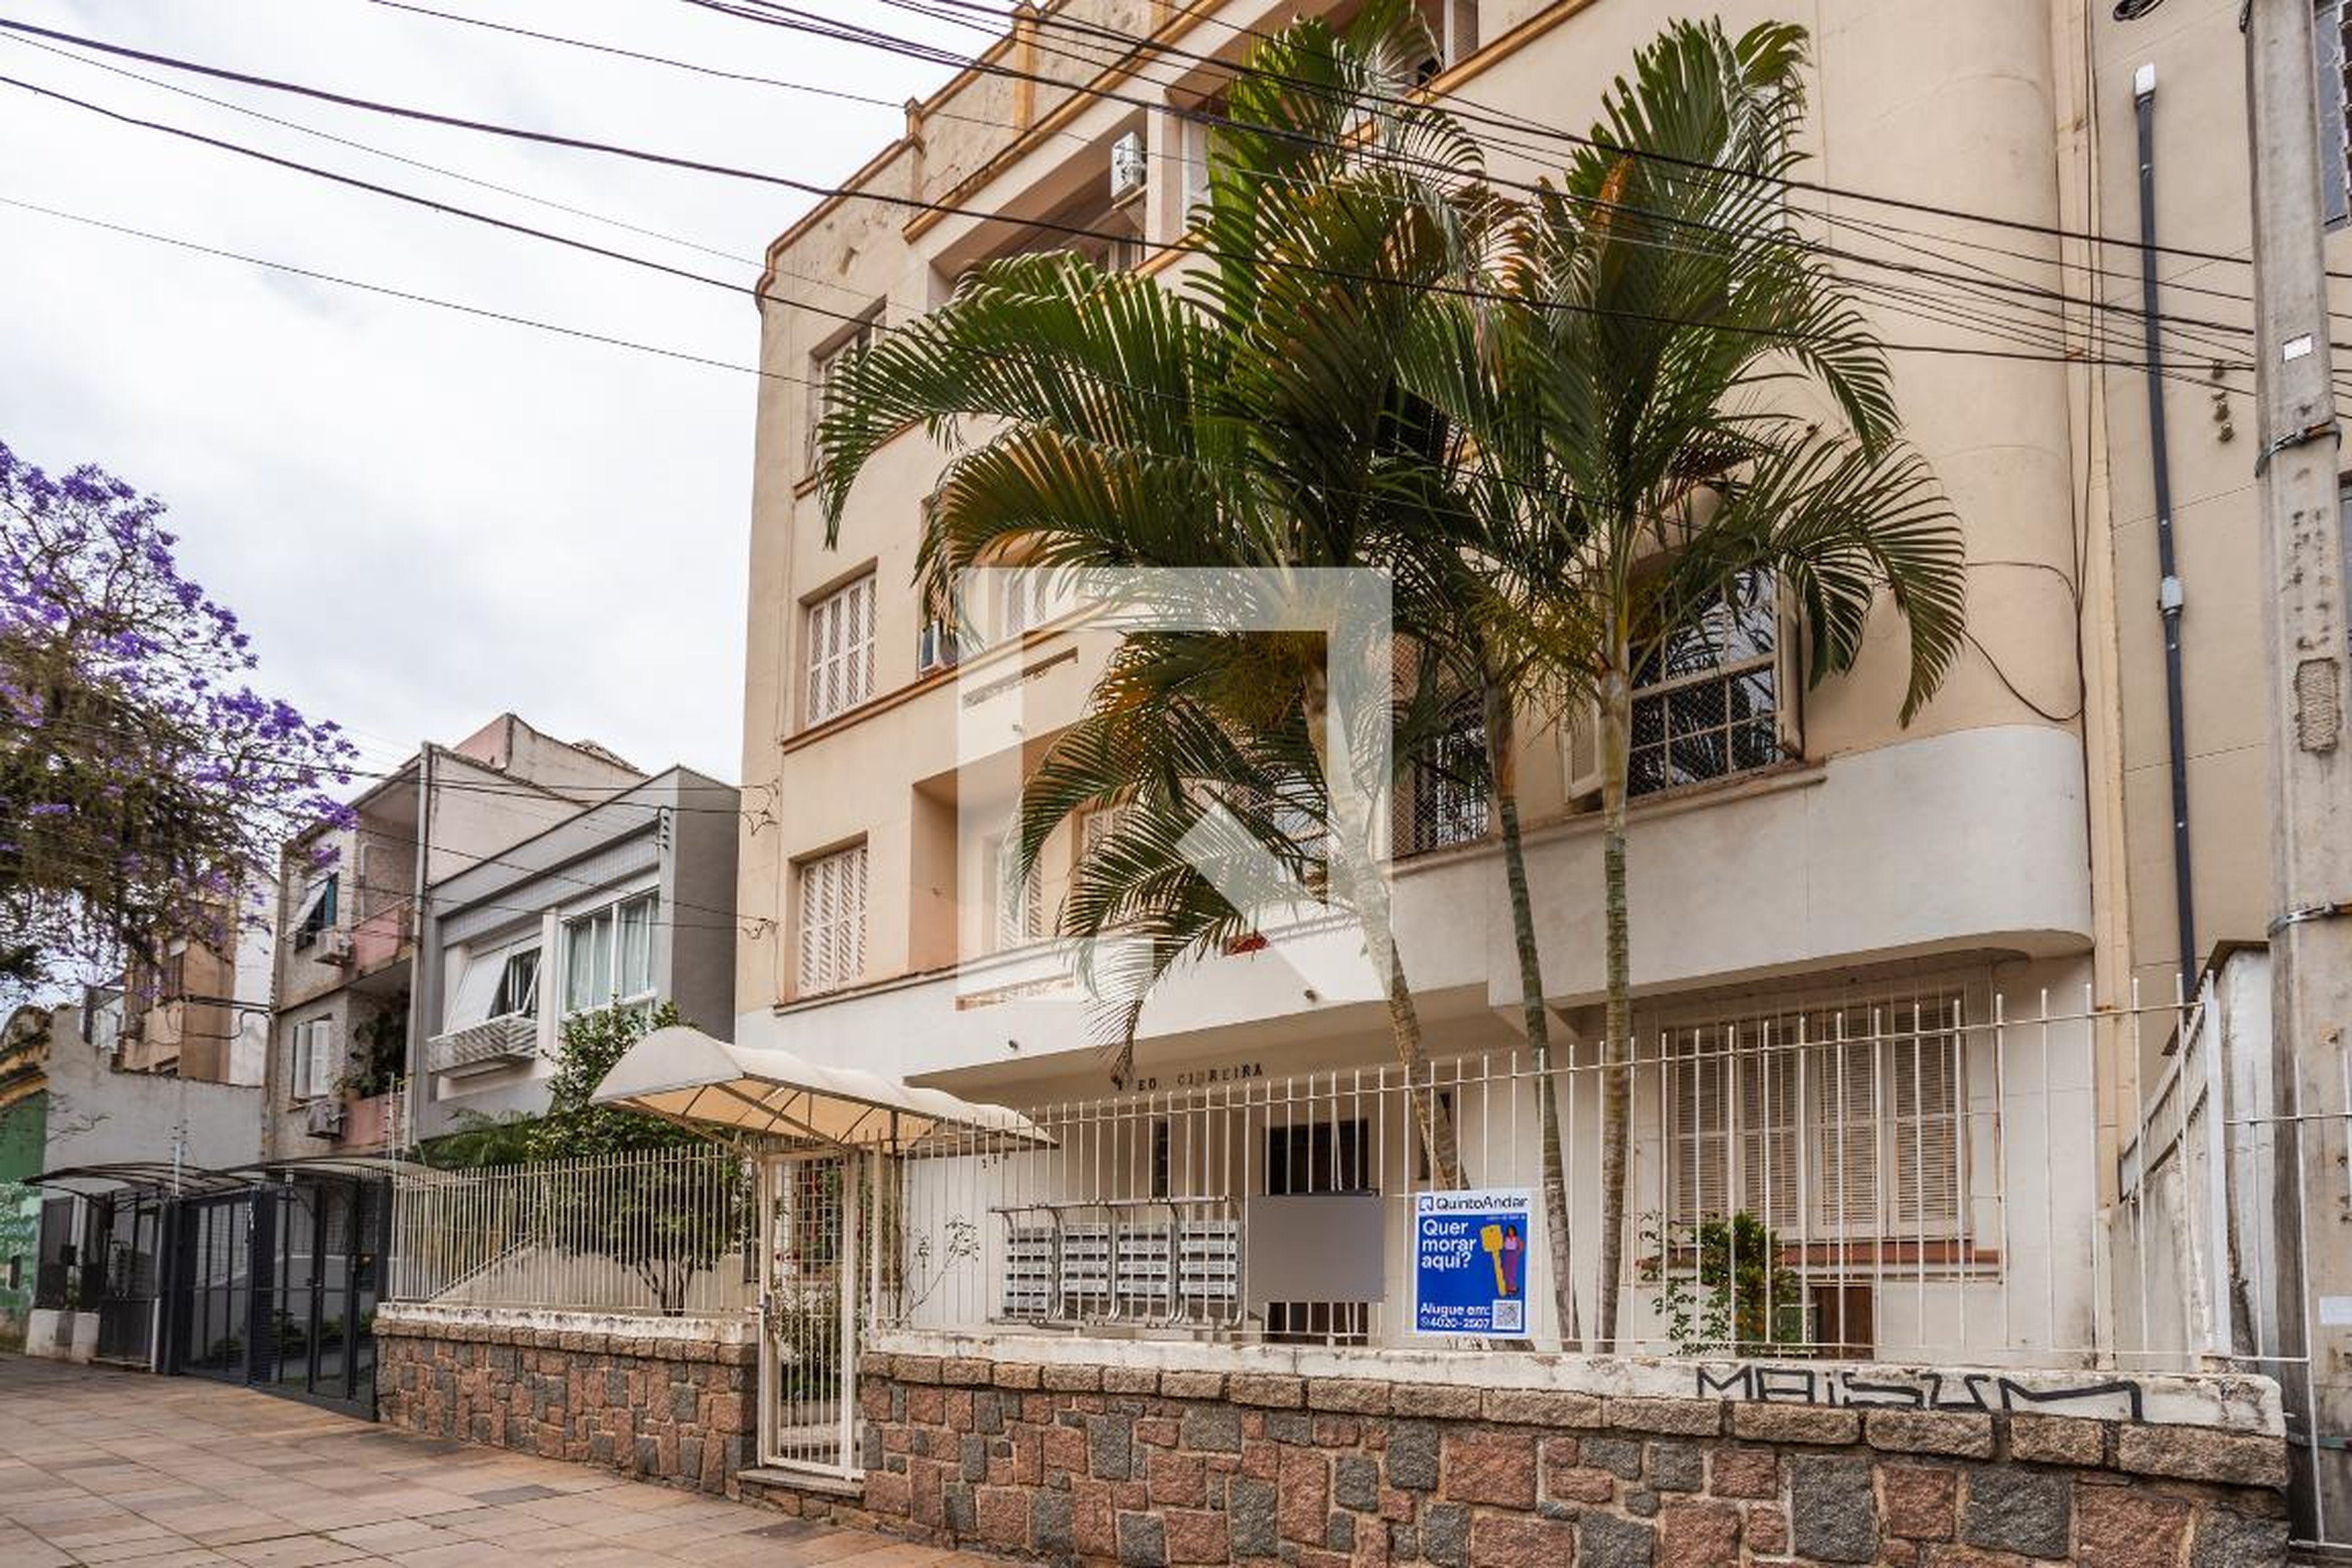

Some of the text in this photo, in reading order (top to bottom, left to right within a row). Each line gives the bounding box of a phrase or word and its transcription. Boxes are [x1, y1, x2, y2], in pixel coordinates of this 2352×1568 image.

[1436, 1196, 1528, 1210] QuintoAndar
[1422, 1219, 1469, 1236] Quer
[1422, 1238, 1477, 1252] morar
[1421, 1253, 1471, 1272] aqui?
[1420, 1302, 1464, 1316] Alugue
